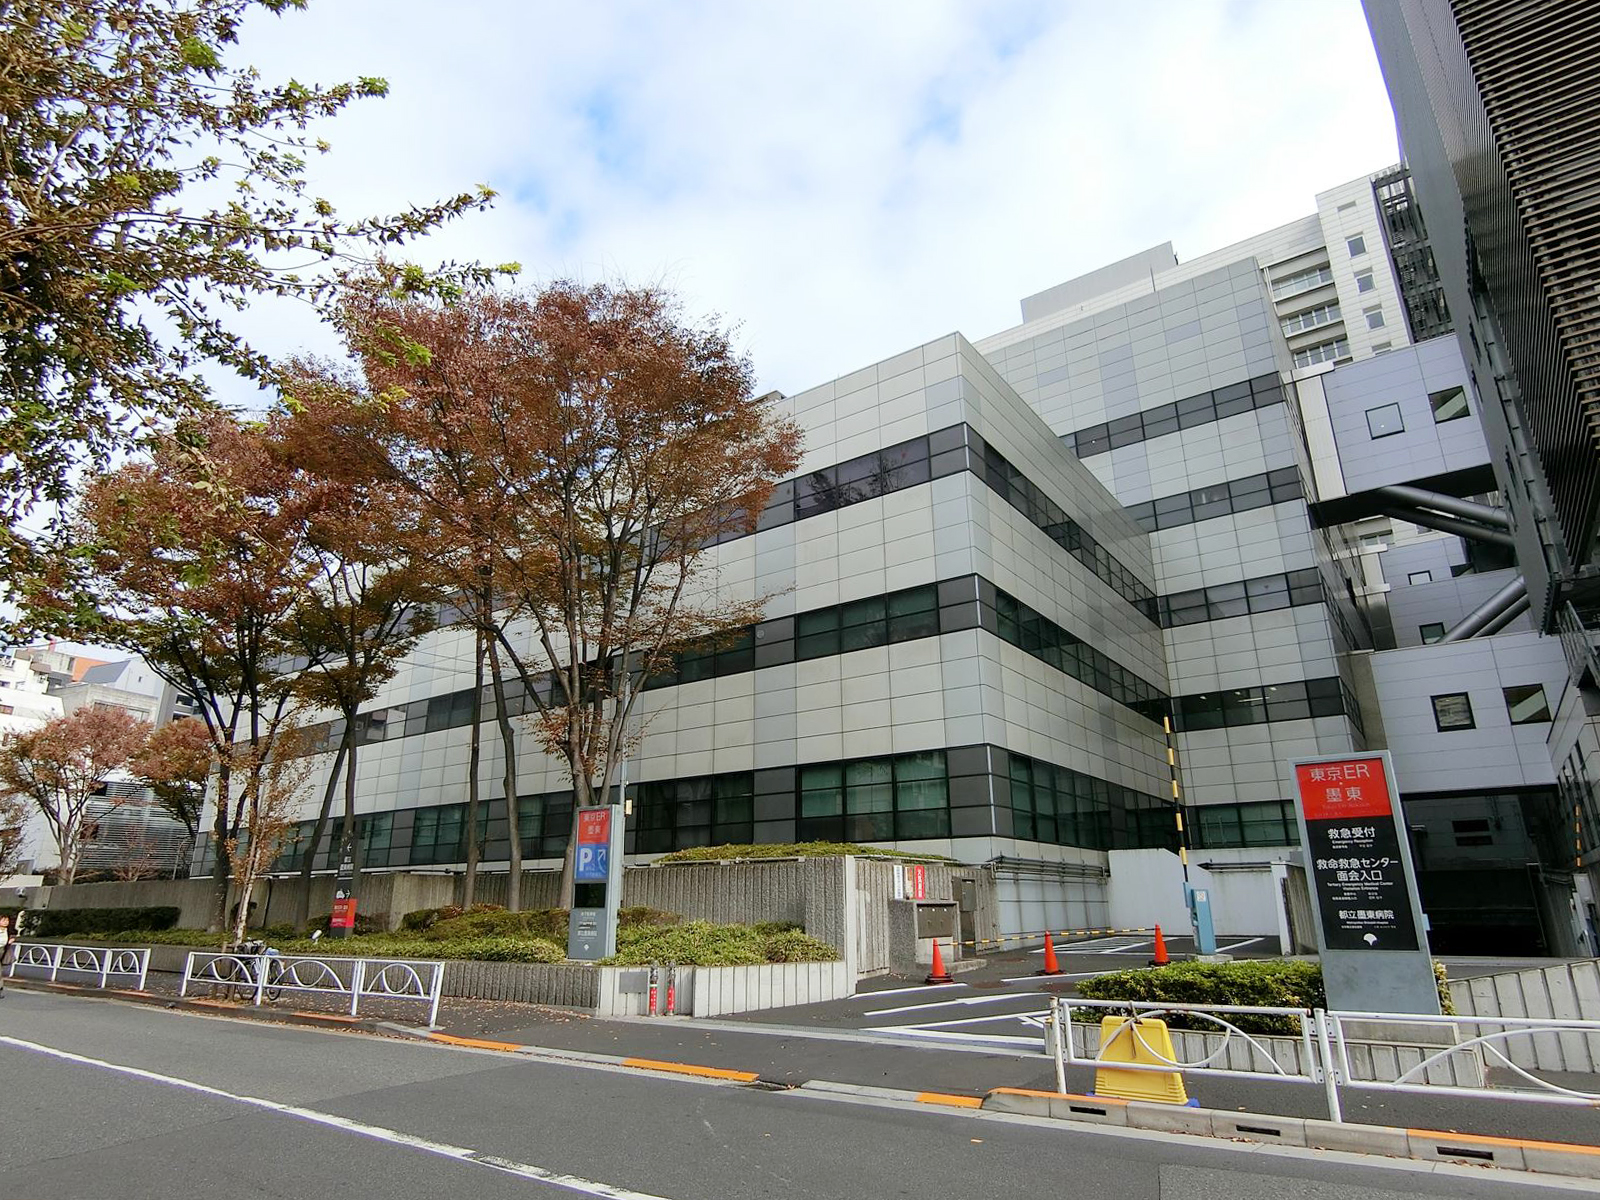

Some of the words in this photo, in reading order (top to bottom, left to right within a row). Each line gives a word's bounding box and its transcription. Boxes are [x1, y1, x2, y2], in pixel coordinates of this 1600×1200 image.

[1310, 764, 1370, 782] 東京ER
[1328, 827, 1375, 839] 救急受付
[579, 847, 593, 872] P
[1317, 858, 1398, 869] 救命救急センター
[1336, 870, 1383, 882] 面会入口
[1339, 910, 1394, 919] 都立墨東病院
